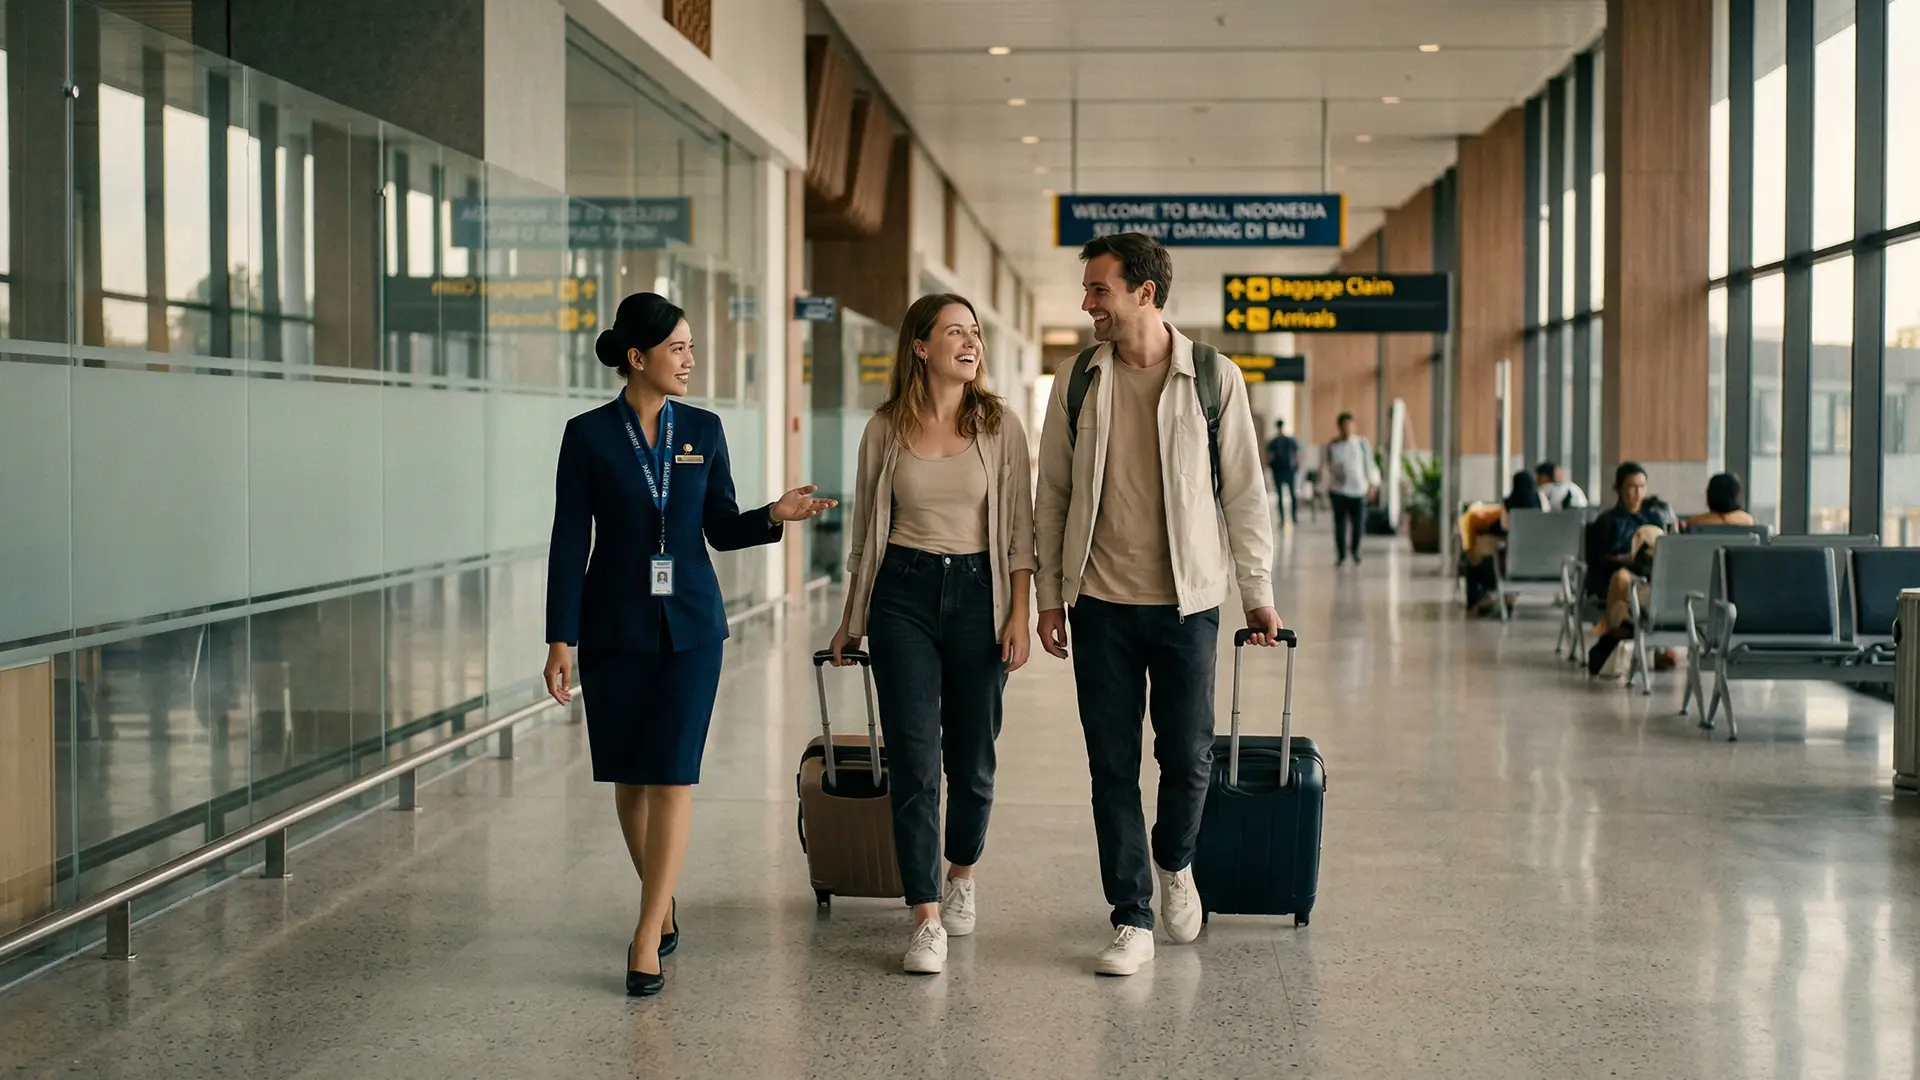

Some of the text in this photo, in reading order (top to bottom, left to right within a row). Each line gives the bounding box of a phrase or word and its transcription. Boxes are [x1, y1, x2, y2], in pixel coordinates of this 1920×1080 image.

[1072, 203, 1156, 220] WELCOME
[1161, 203, 1184, 220] TO
[1233, 203, 1327, 220] INDONESIA
[1173, 223, 1242, 239] DATANG
[1245, 223, 1264, 239] DI
[1267, 222, 1305, 239] BALI
[1271, 276, 1395, 300] Baggage Claim
[1272, 308, 1337, 328] Arrivals
